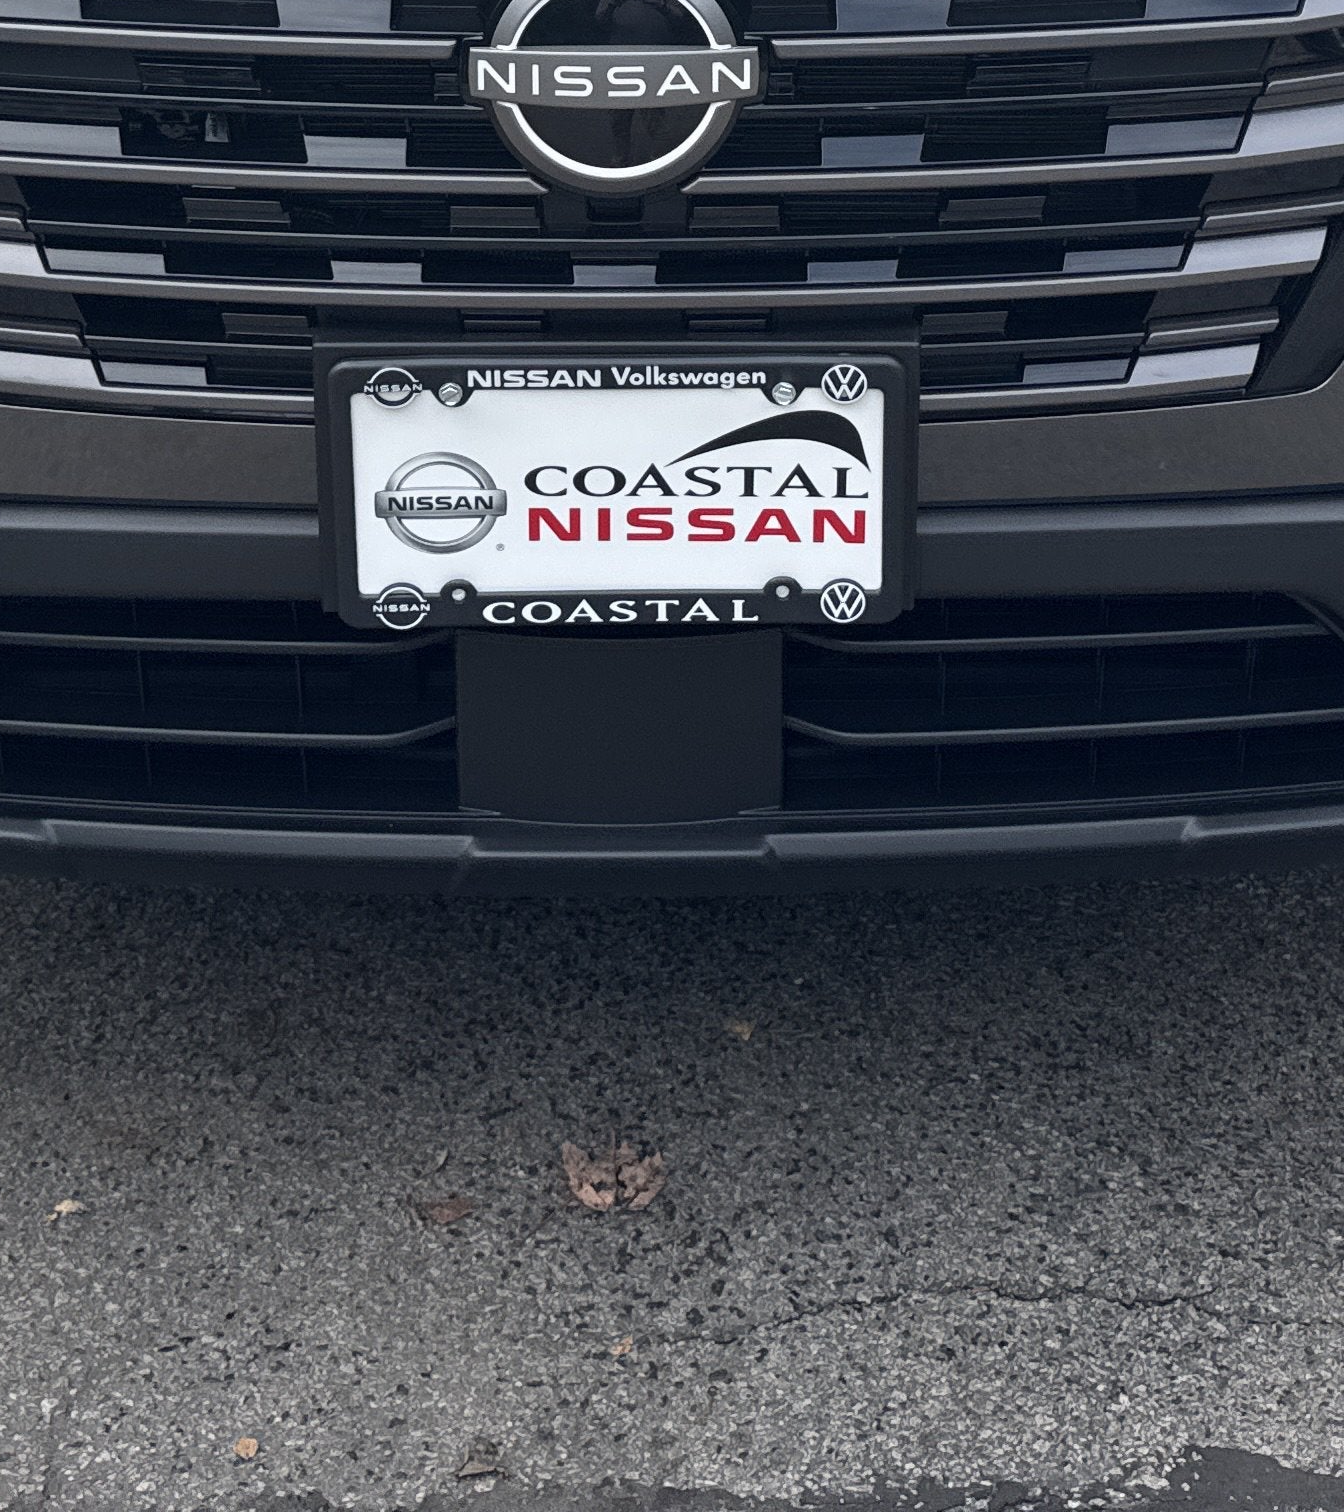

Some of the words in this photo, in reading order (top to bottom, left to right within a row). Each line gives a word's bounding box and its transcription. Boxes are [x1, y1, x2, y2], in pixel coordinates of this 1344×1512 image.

[476, 58, 751, 98] NISSAN
[363, 381, 423, 394] NISSAN
[467, 369, 602, 388] NISSAN
[610, 366, 767, 389] Volkswagen
[523, 463, 870, 499] COASTAL
[387, 494, 494, 512] NISSAN
[528, 507, 866, 544] NISSAN
[372, 601, 431, 614] NISSAN
[482, 598, 759, 624] COASTAL
